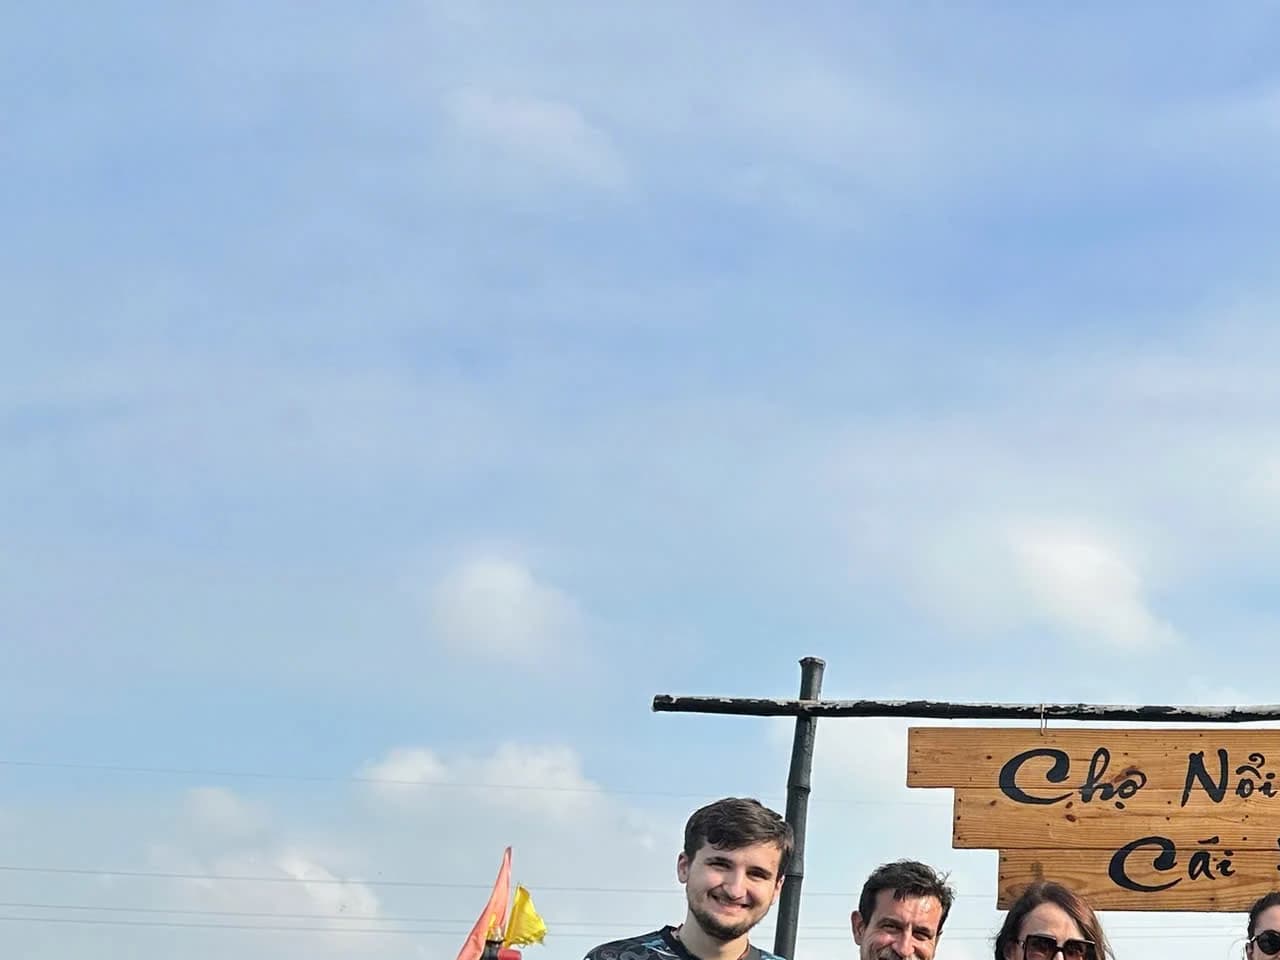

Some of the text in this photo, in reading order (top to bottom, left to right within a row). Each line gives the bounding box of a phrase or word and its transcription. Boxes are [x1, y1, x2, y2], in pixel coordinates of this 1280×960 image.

[998, 747, 1278, 809] Chợ Nổi
[1108, 836, 1236, 892] Cái
